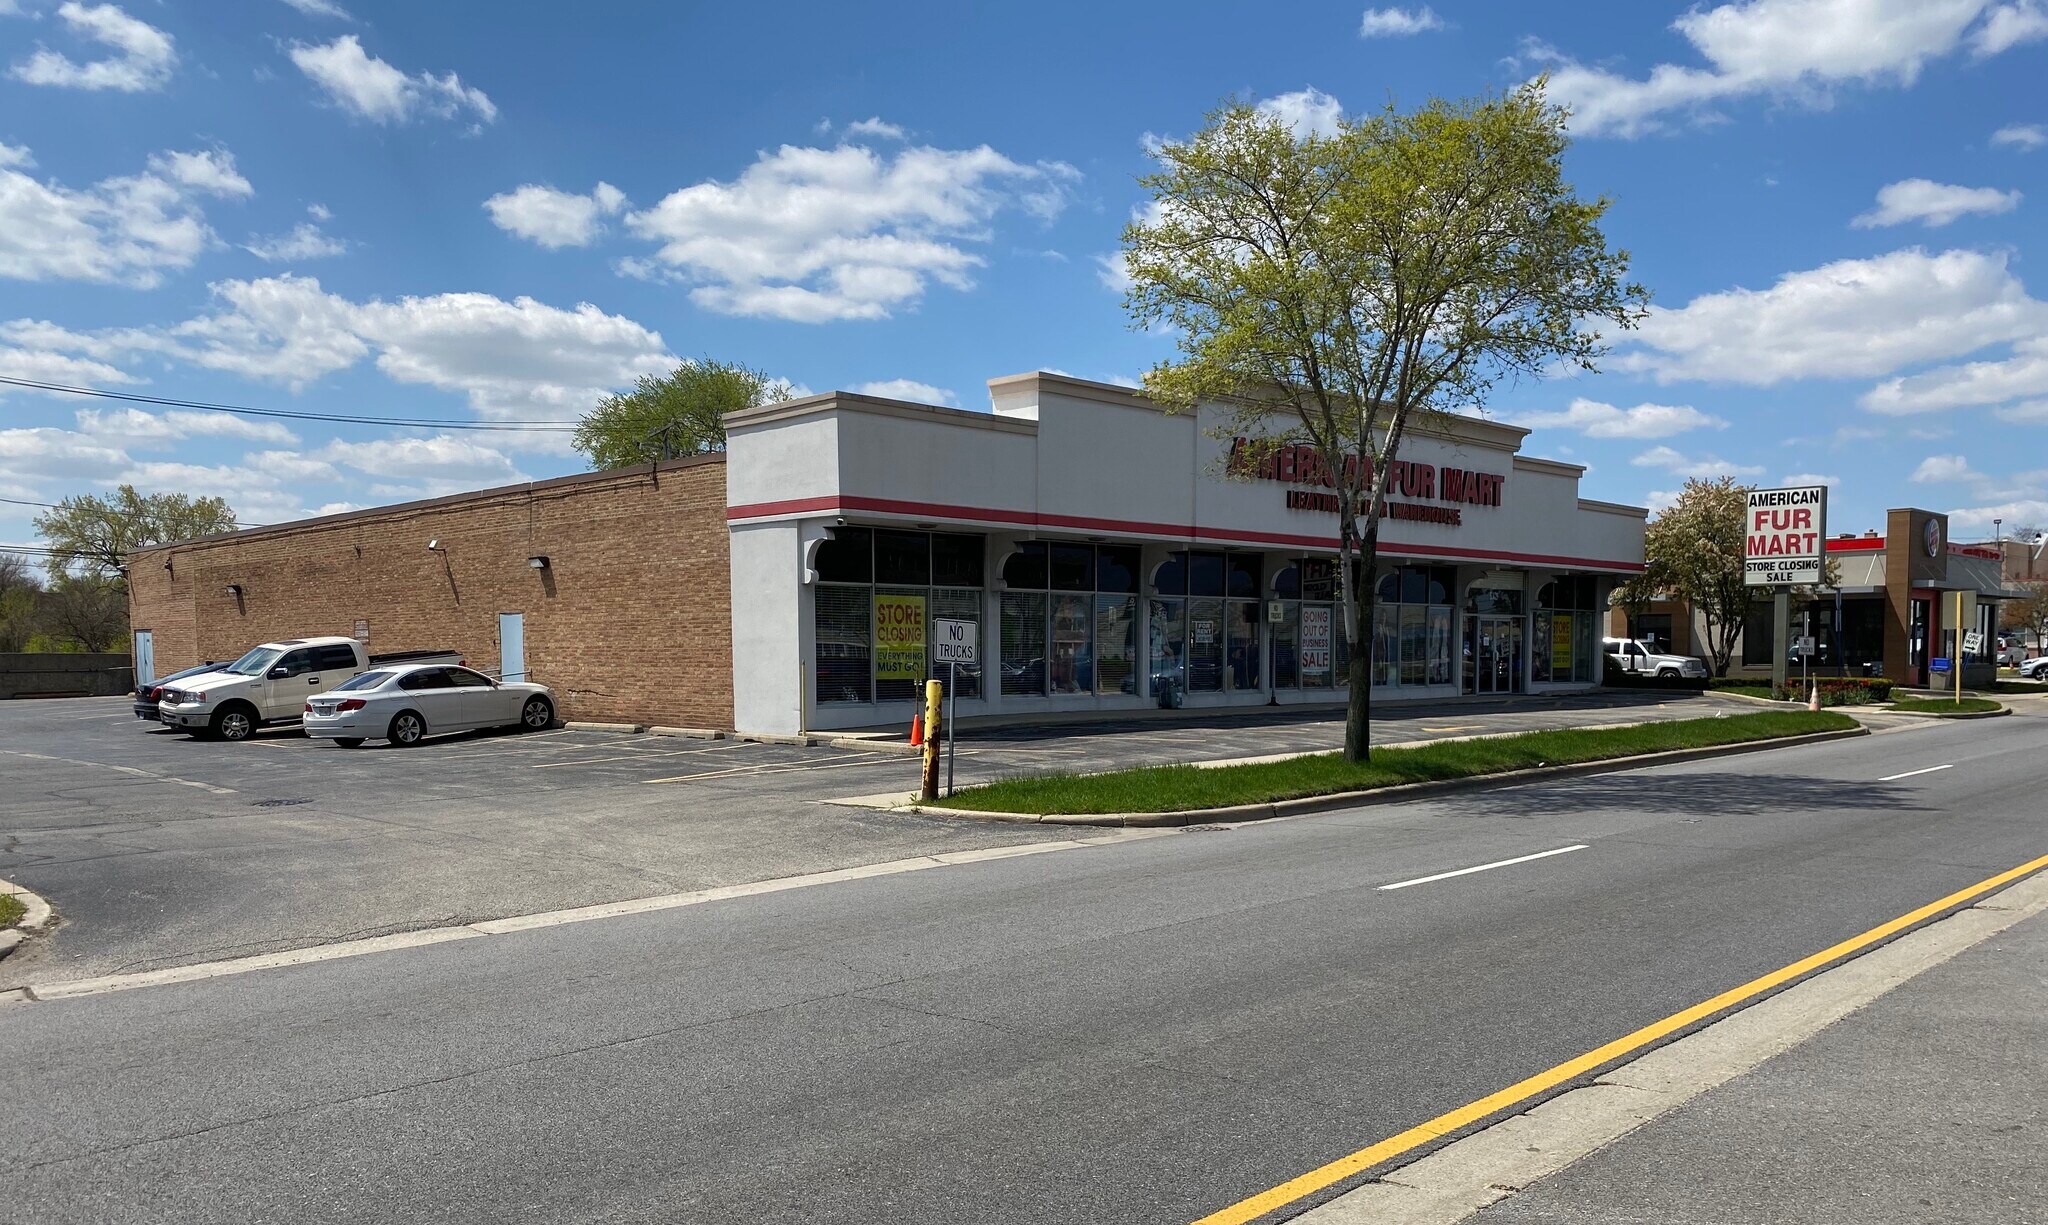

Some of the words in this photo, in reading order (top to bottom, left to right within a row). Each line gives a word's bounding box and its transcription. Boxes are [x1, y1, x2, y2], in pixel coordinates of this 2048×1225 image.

[1386, 460, 1436, 499] FUR
[1440, 467, 1505, 507] MART
[1748, 490, 1819, 507] AMERICAN
[1286, 490, 1344, 514] LEATHE
[1389, 502, 1462, 527] WAREHOUSE
[1754, 508, 1812, 532] FUR
[1747, 532, 1818, 557] MART
[1746, 561, 1776, 572] STORE
[1778, 560, 1819, 571] CLOSING
[1766, 572, 1793, 582] SALE
[877, 603, 922, 625] STORE
[1303, 611, 1328, 623] GOING
[877, 626, 922, 642] CLOSING
[949, 625, 964, 641] NO
[1303, 625, 1317, 636] OUT
[1318, 625, 1328, 636] OF
[1967, 633, 1980, 641] ONE
[1302, 638, 1328, 648] BUSINESS
[878, 651, 923, 661] EVERYTHING
[940, 644, 973, 659] TRUCKS
[877, 662, 902, 672] MUST
[1302, 652, 1328, 668] SALE
